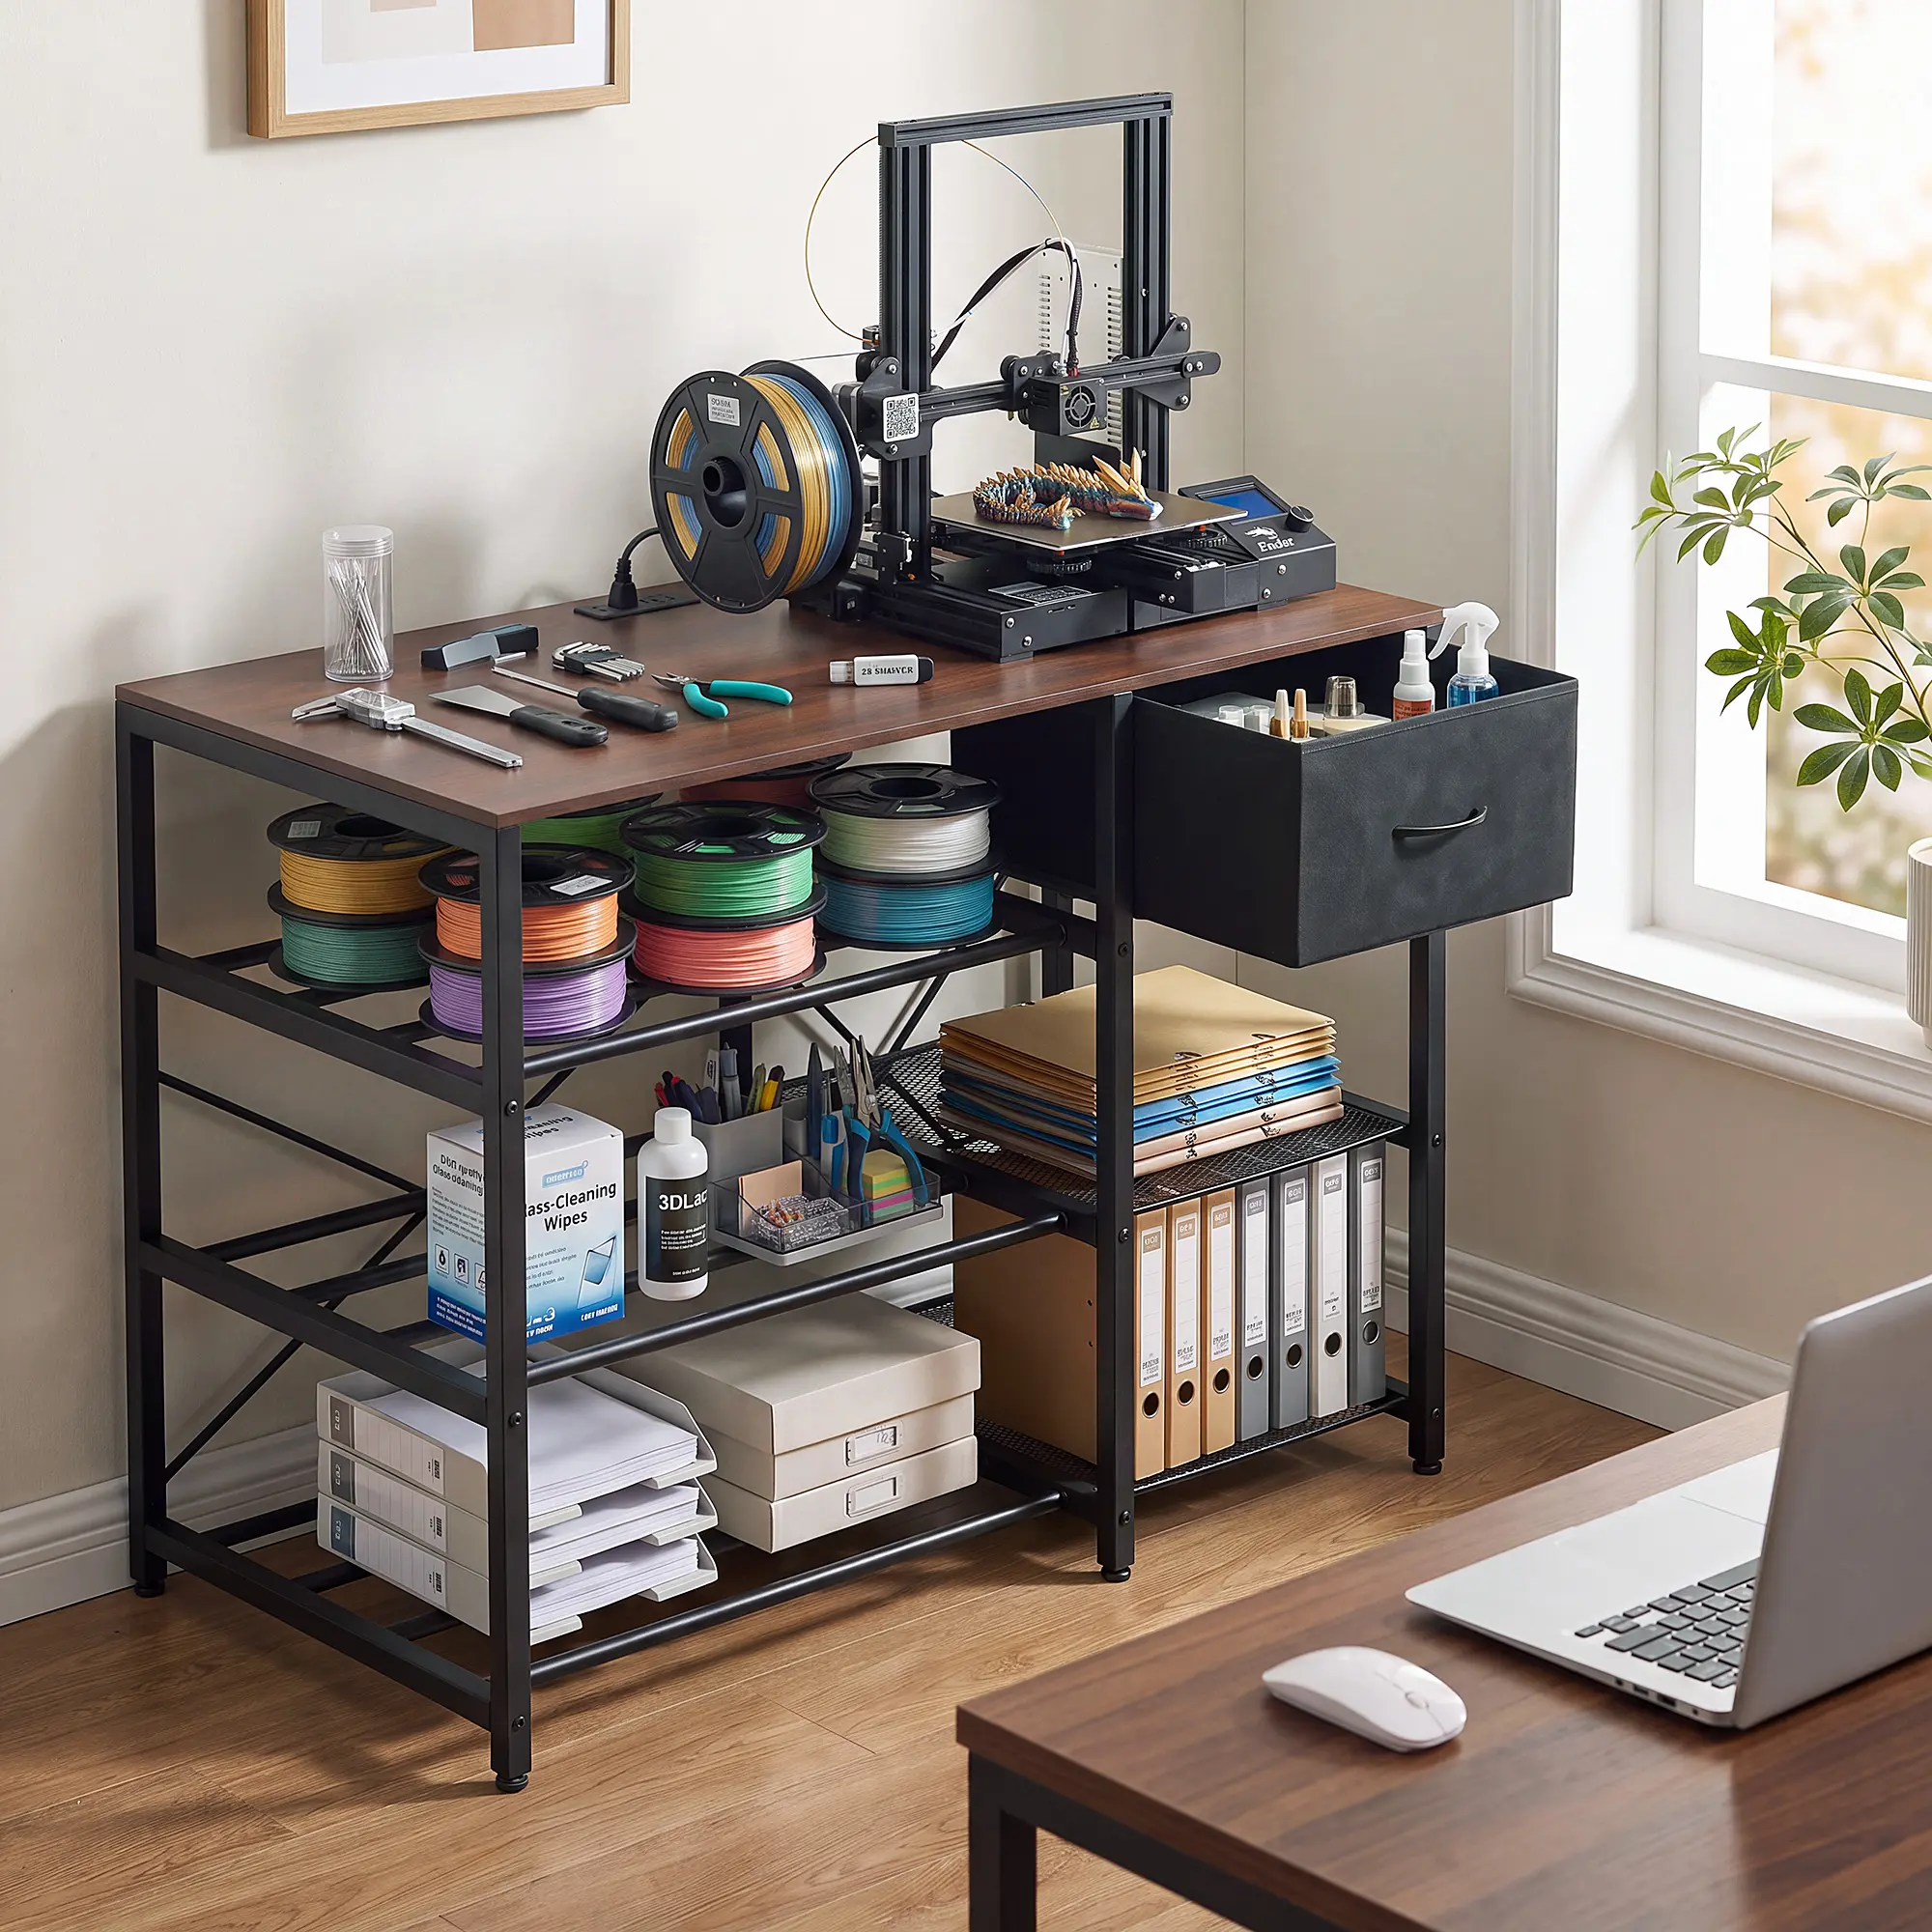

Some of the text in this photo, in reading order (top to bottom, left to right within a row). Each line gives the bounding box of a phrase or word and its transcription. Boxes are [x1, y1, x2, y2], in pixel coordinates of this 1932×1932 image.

[1257, 538, 1294, 552] Ender
[525, 1183, 616, 1217] lass-Cleaning
[659, 1189, 708, 1210] 3DLac
[544, 1211, 587, 1232] Wipes
